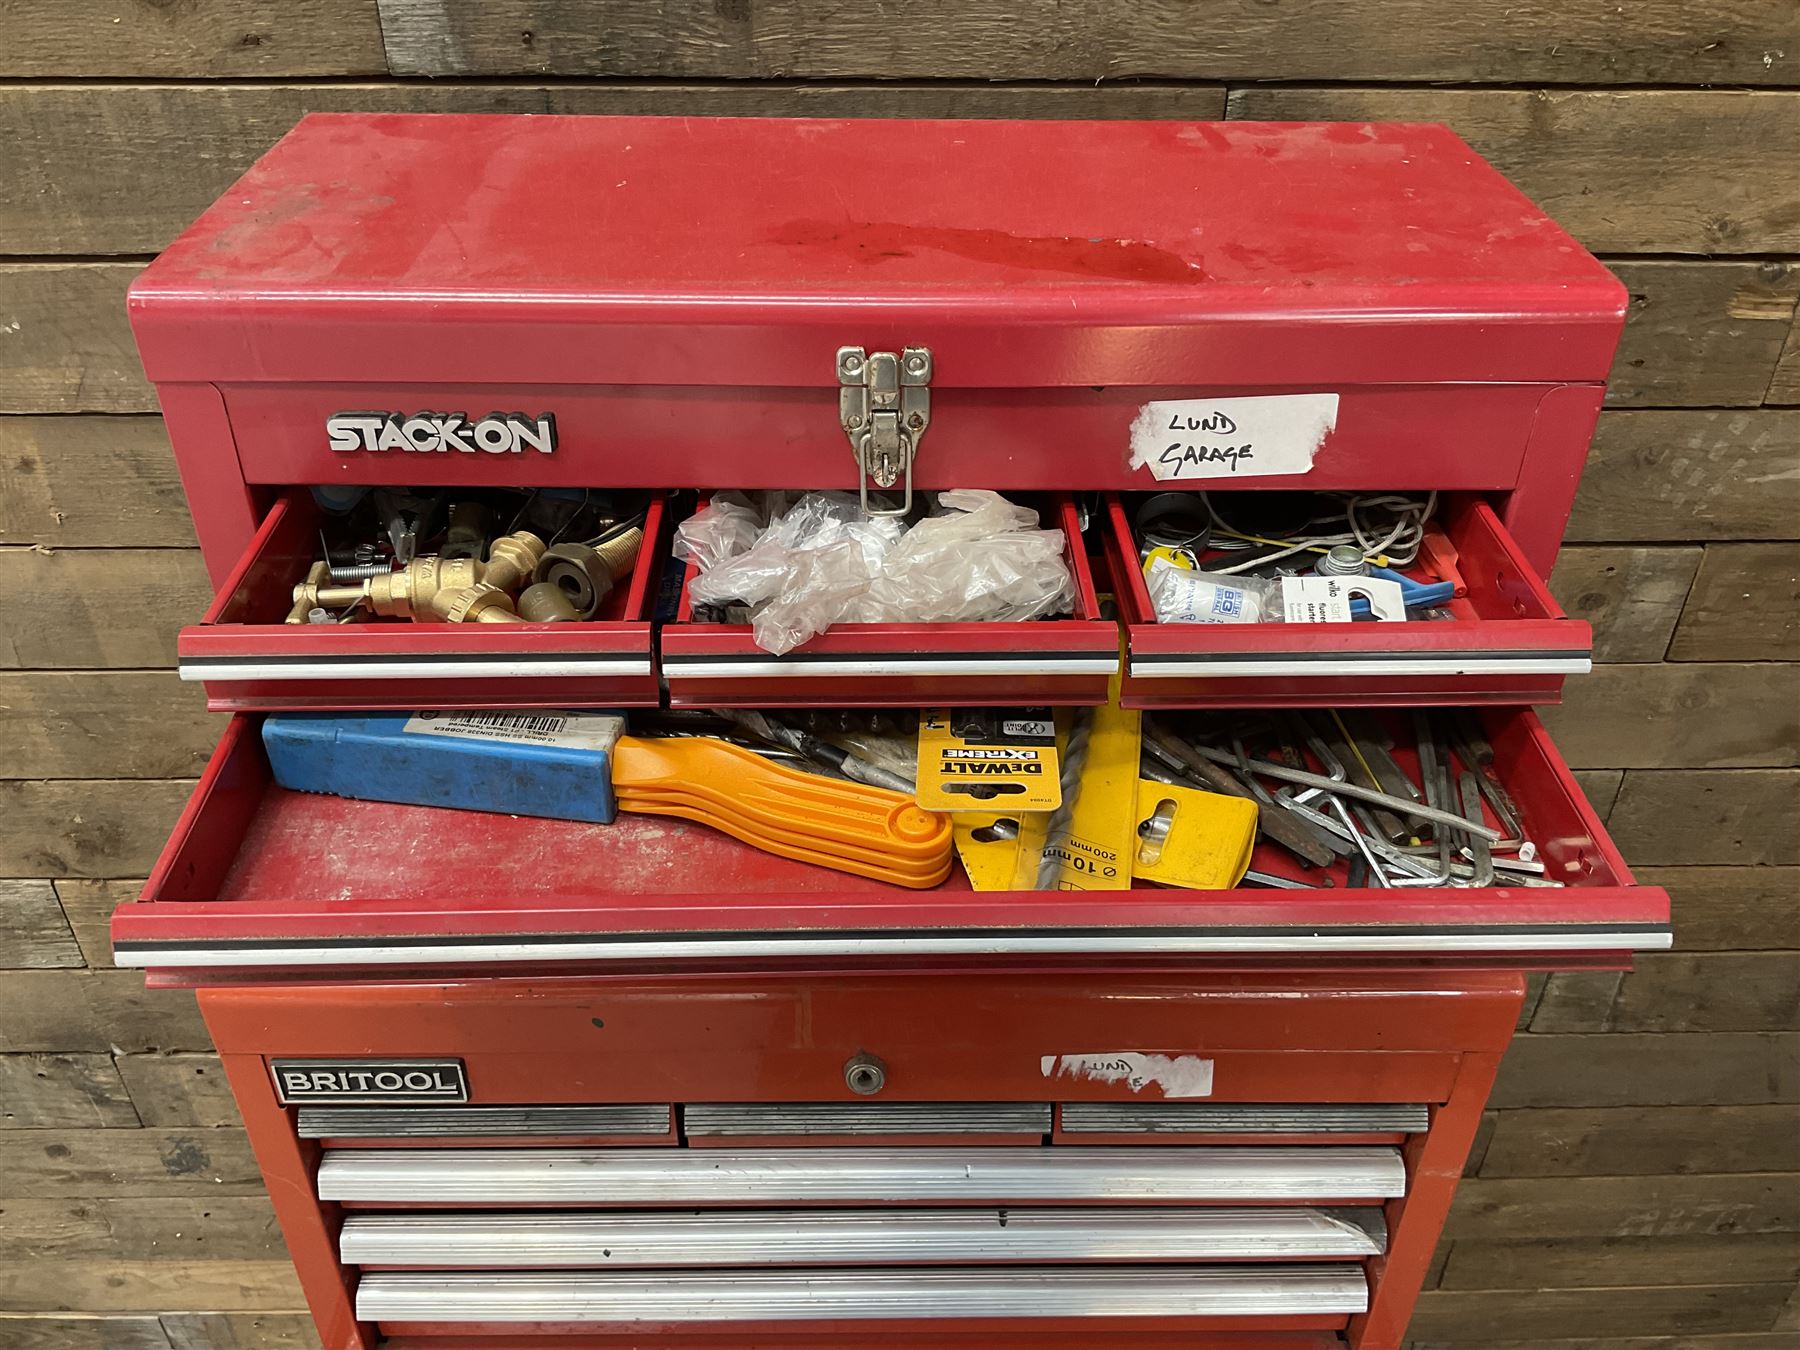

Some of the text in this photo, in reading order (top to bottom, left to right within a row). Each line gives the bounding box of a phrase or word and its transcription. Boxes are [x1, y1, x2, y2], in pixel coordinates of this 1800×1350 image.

[326, 410, 558, 454] STACK-ON
[1168, 411, 1237, 435] LUND
[1158, 443, 1254, 476] GARAGE
[1328, 580, 1339, 597] wilko
[946, 749, 1036, 760] EXTREME
[1043, 850, 1071, 861] mm
[1070, 840, 1116, 860] 200 mm
[1074, 857, 1096, 873] 10
[283, 1072, 457, 1090] BRITOOL
